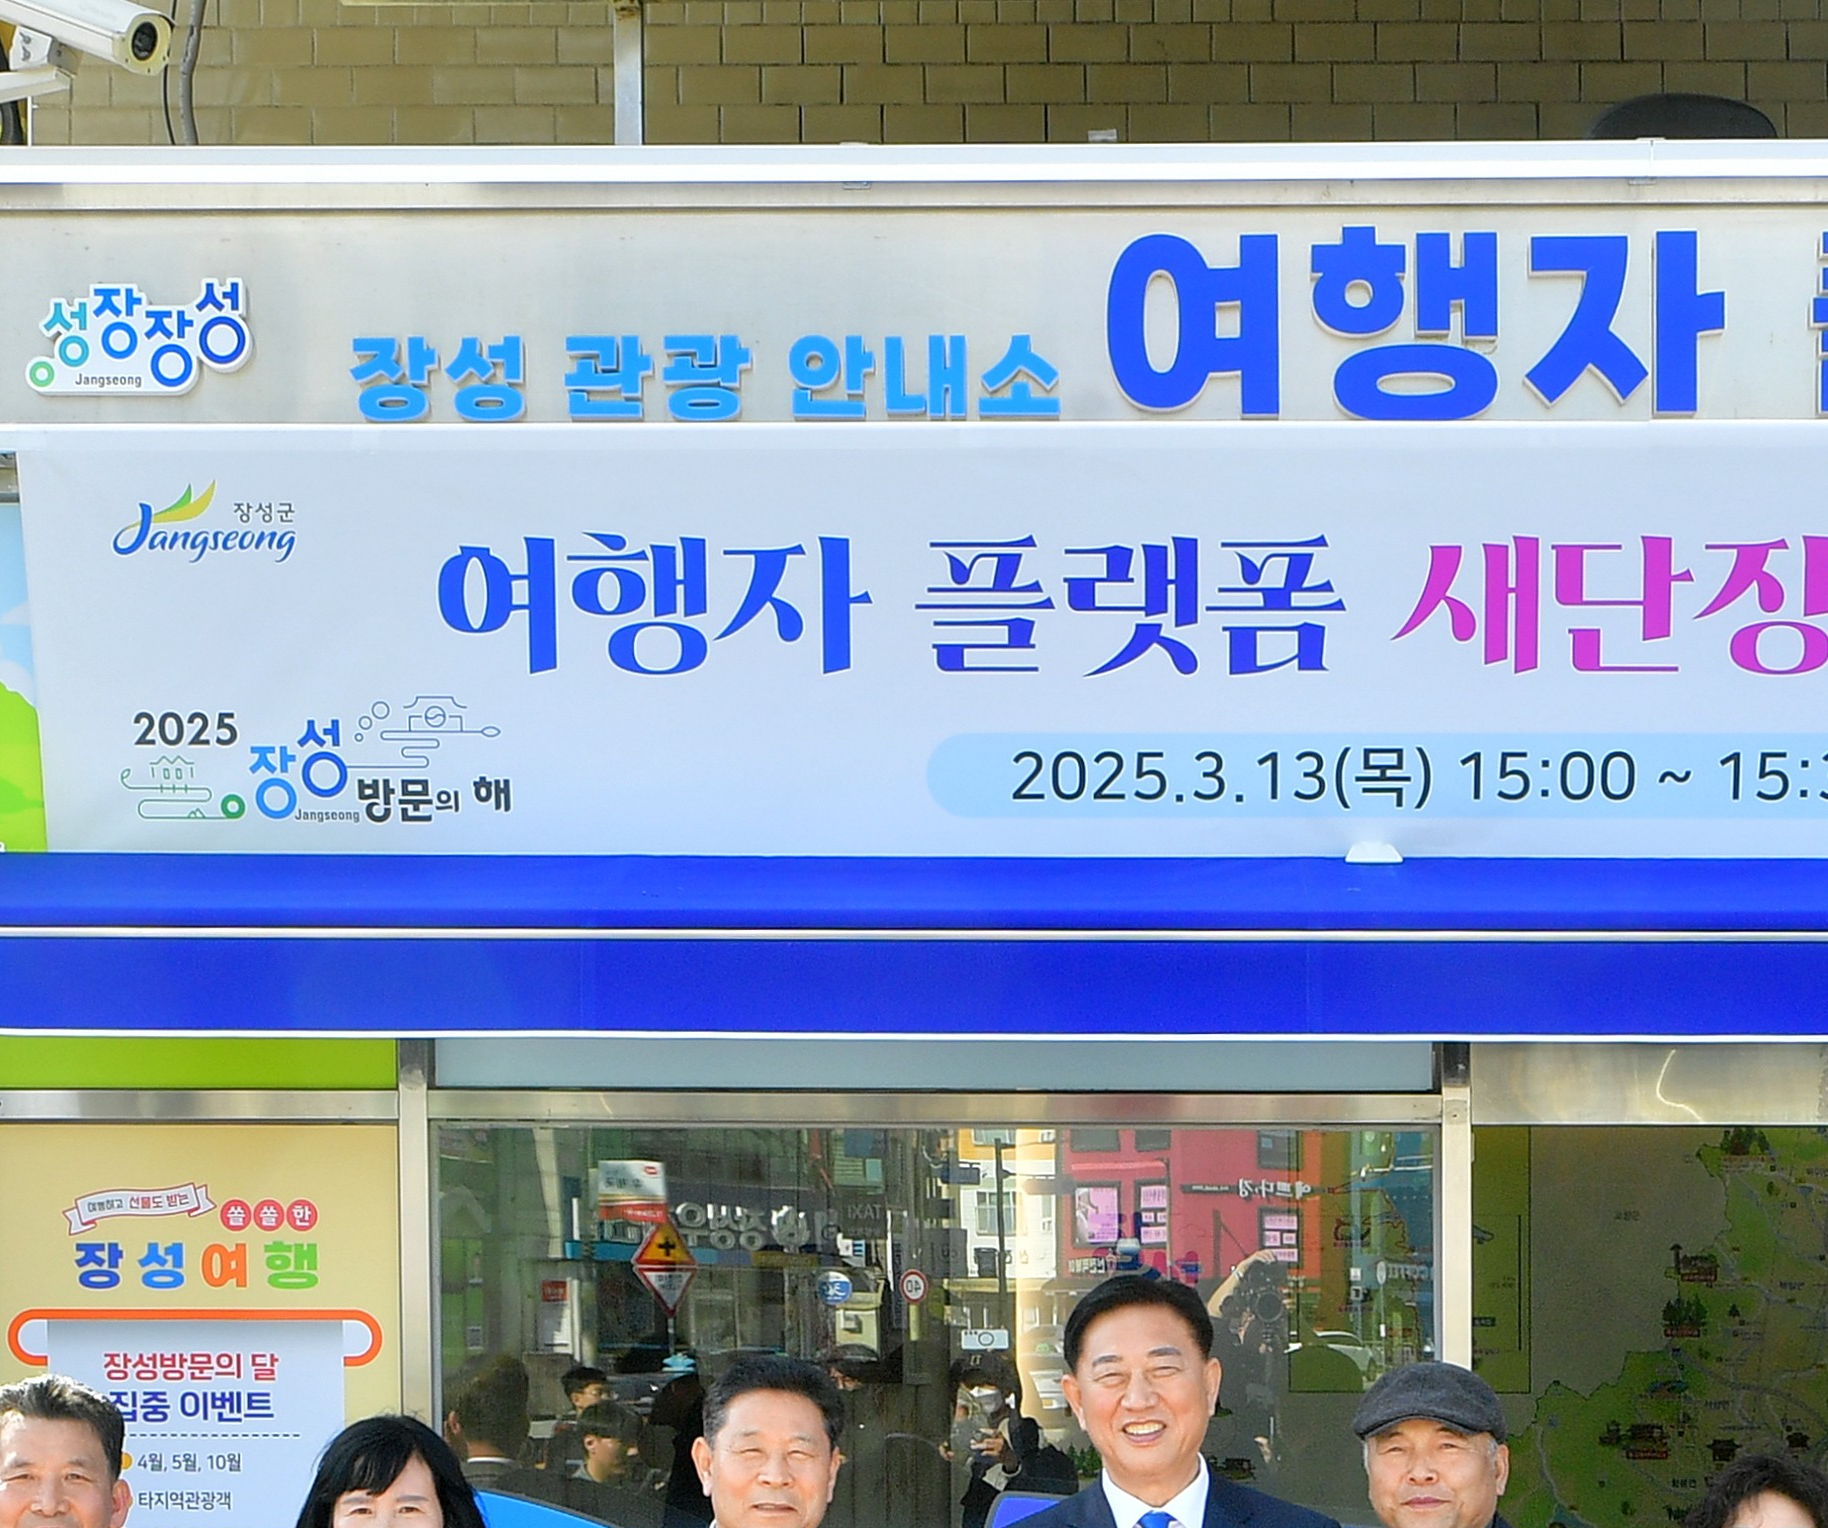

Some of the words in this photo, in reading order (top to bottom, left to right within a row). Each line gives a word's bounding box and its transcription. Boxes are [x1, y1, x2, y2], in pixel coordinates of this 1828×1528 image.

[27, 278, 250, 390] 성장장성
[350, 335, 528, 421] 장성
[564, 335, 753, 421] 관광
[789, 333, 1061, 421] 안내소
[1105, 225, 1725, 421] 여행자
[74, 372, 143, 389] Jangseong
[232, 501, 295, 523] 장성군
[112, 500, 297, 564] Jangseong
[437, 533, 872, 677] 여행자
[914, 533, 1347, 677] 플랫폼
[132, 711, 239, 747] 2025
[247, 716, 348, 820] 장성
[356, 776, 461, 824] 방문의
[472, 776, 512, 814] 해
[1012, 745, 1432, 812] 2025.3.13(목)
[1459, 747, 1636, 804] 15:00
[294, 807, 360, 824] Jangseong
[128, 1195, 163, 1209] 선물도
[166, 1191, 190, 1207] 받는
[103, 1353, 243, 1381] 장성방문의
[251, 1353, 279, 1381] 달
[110, 1390, 170, 1422] 집중
[180, 1390, 275, 1423] 이벤트
[137, 1453, 167, 1472] 4월,
[172, 1453, 202, 1472] 5월,
[207, 1453, 242, 1472] 10월
[138, 1490, 232, 1511] 타지역관광객
